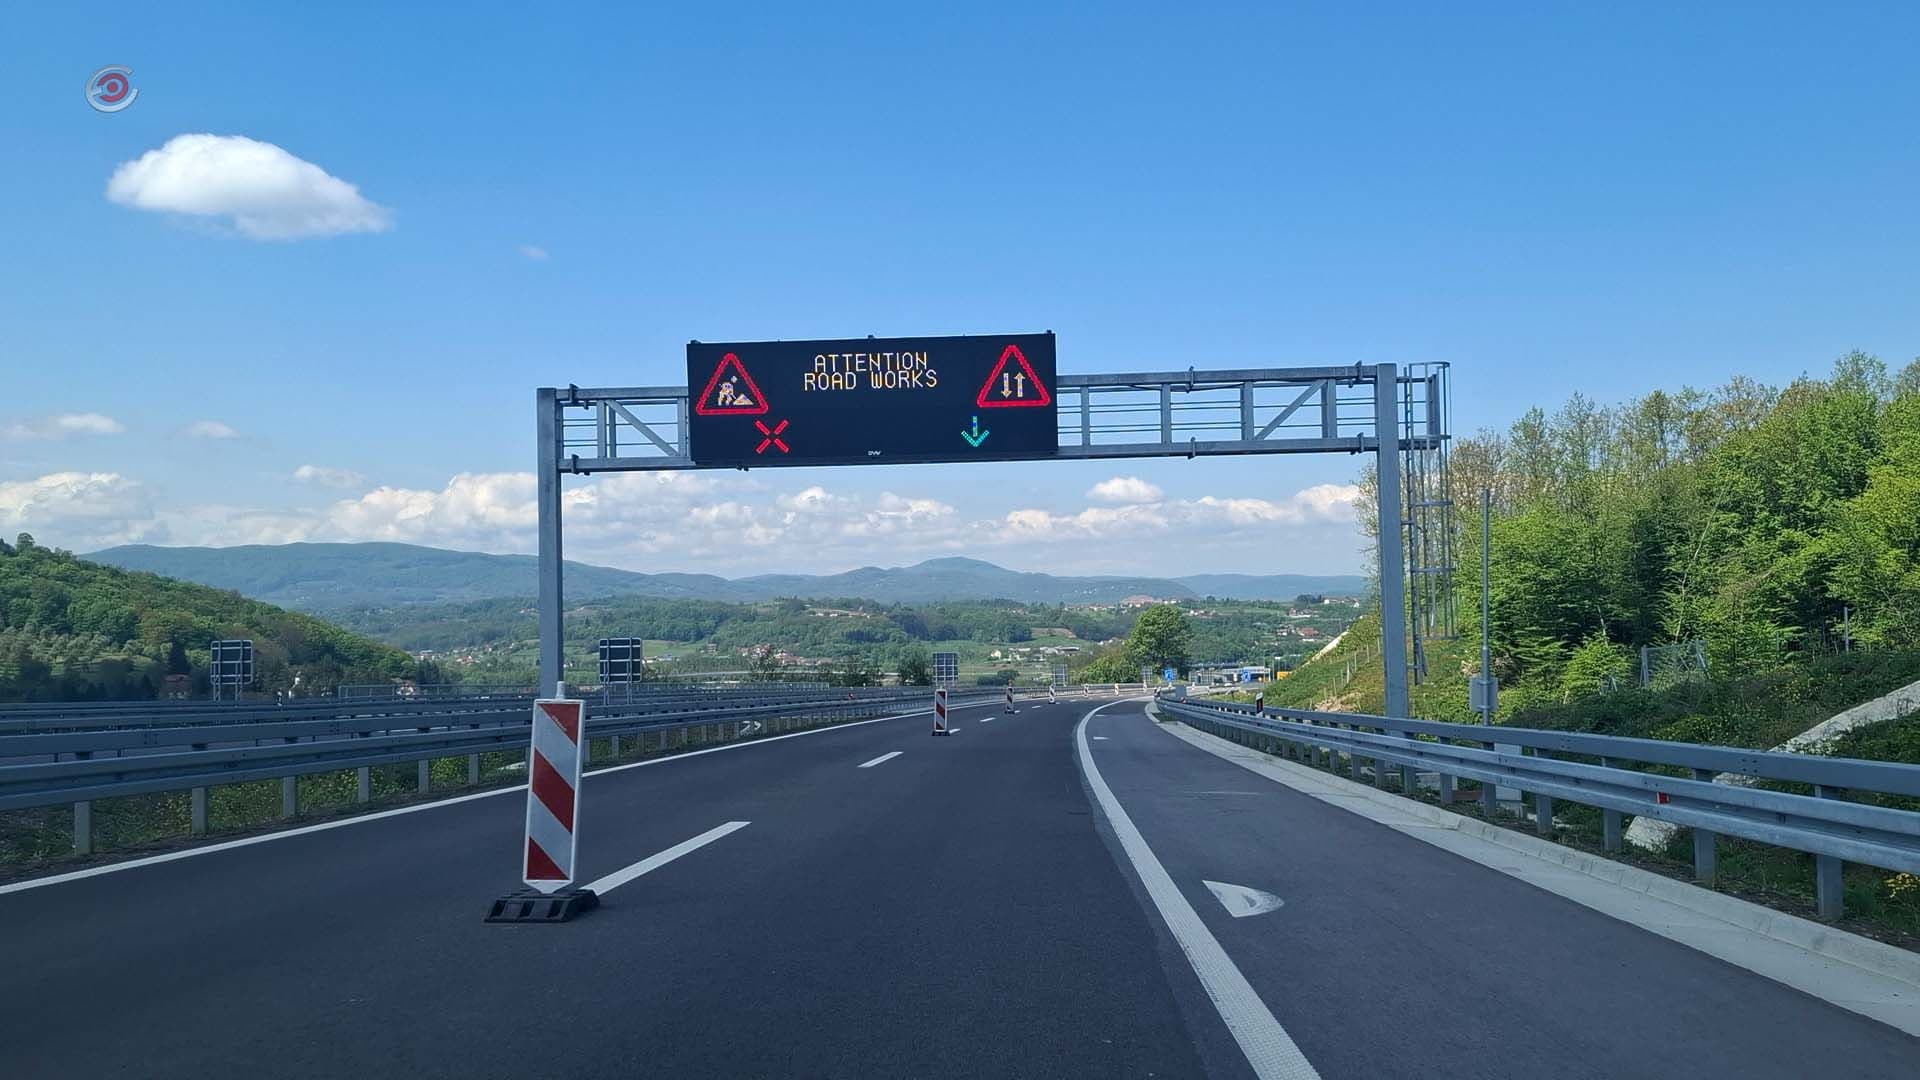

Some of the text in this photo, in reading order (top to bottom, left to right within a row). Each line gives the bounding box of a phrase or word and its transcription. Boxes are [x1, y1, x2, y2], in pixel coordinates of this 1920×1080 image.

[814, 351, 927, 373] ATTENTION
[804, 369, 937, 391] ROAD WORKS
